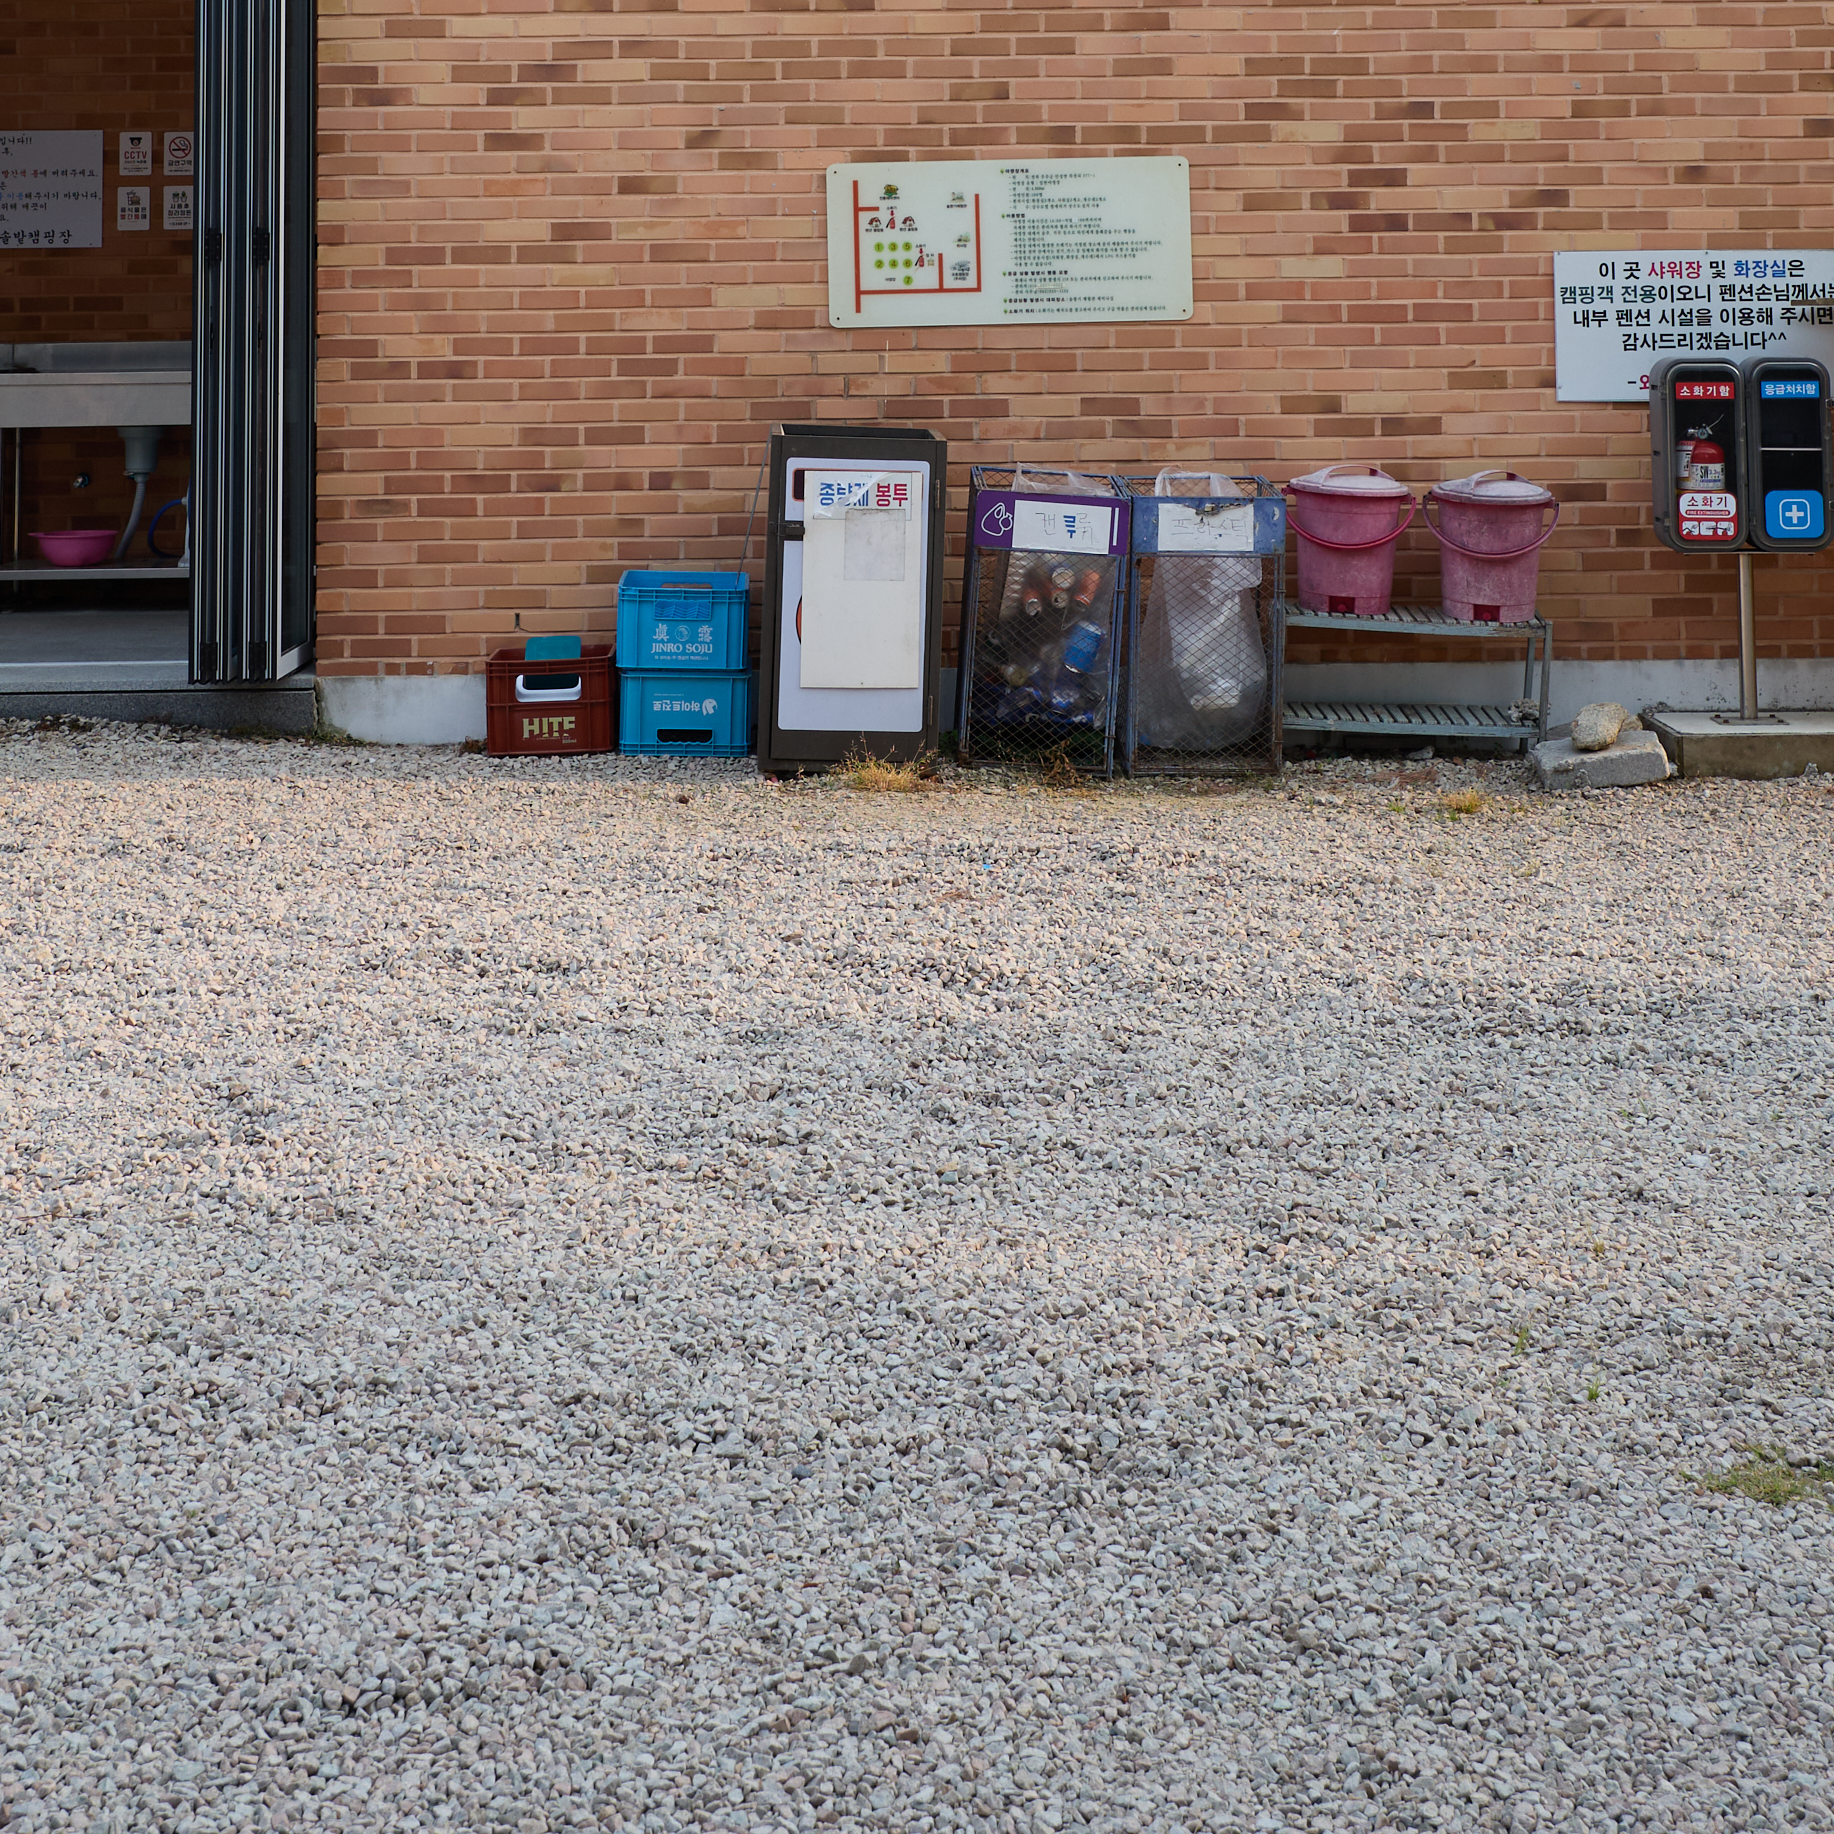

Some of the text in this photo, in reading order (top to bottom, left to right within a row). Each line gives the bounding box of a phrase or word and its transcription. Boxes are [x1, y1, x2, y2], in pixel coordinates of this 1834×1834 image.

[124, 151, 148, 160] CCTV
[1, 202, 17, 211] 위해
[1599, 259, 1805, 280] 이 곳 샤워장 및 화장실은
[1560, 285, 1614, 305] 캠핑객
[1621, 283, 1711, 303] 전용이오니
[1573, 306, 1833, 328] 내부 펜션 시설을 이용해 주시면
[1622, 331, 1787, 351] 감사드리겠습니다^^
[1679, 385, 1730, 397] 소화기함
[1765, 383, 1816, 396] 응급처치함
[876, 483, 908, 507] 봉투
[1687, 496, 1728, 508] 소화기
[651, 643, 713, 654] JINRO SOJU
[652, 700, 701, 712] 하이트진로
